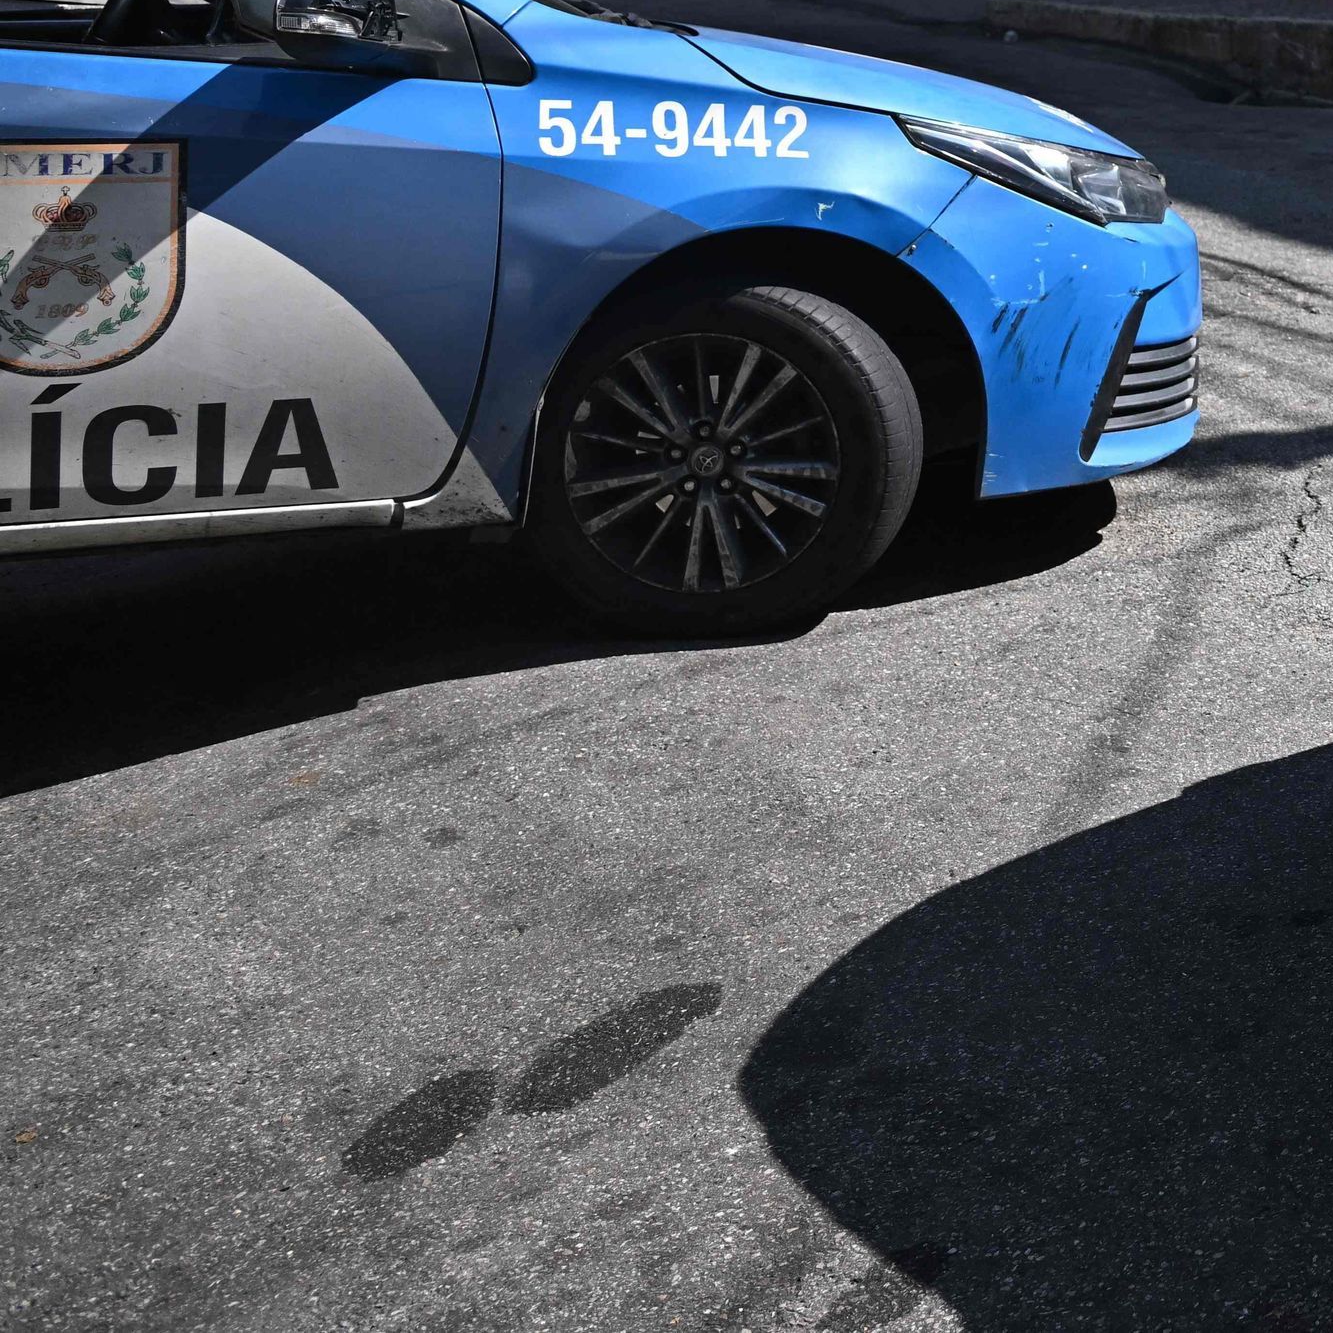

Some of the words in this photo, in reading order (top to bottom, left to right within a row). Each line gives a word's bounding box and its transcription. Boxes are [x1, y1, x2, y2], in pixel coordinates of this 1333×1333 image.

[538, 99, 811, 159] 54-9442
[35, 303, 89, 319] 1809
[0, 382, 340, 513] ÍCIA
